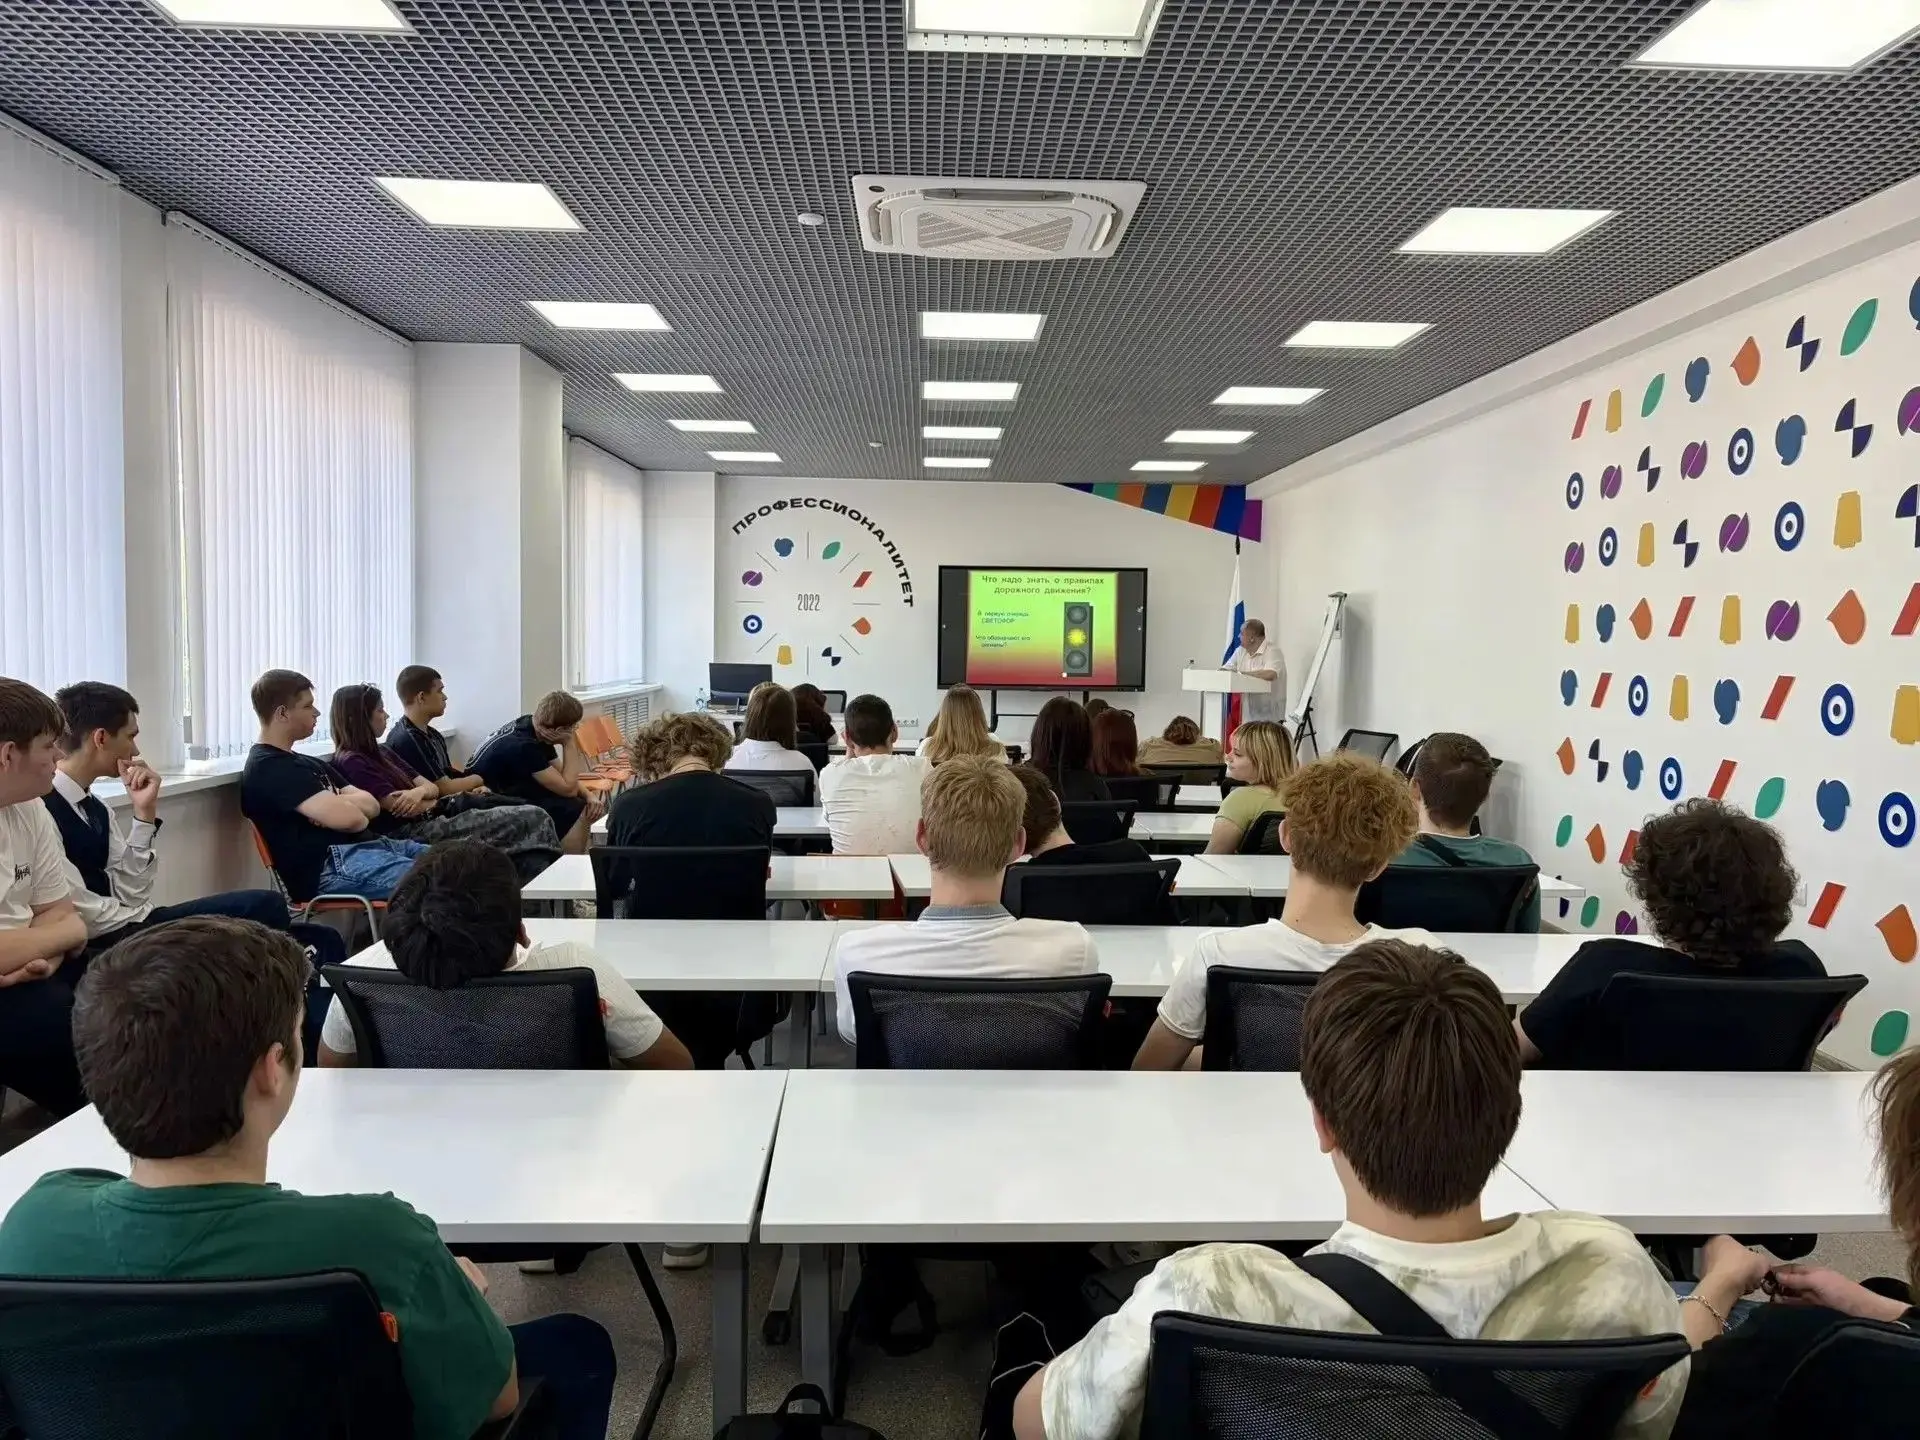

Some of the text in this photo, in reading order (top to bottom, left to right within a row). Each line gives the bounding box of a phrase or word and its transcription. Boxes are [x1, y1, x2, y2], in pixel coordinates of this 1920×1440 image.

[732, 497, 914, 608] ПРОФЕССИОНАЛИТЕТ
[981, 575, 998, 584] Что
[1001, 577, 1023, 585] надо
[1026, 576, 1050, 585] знать
[1064, 577, 1105, 586] правилах
[994, 586, 1092, 595] дорожного движения?
[797, 593, 821, 612] 2022
